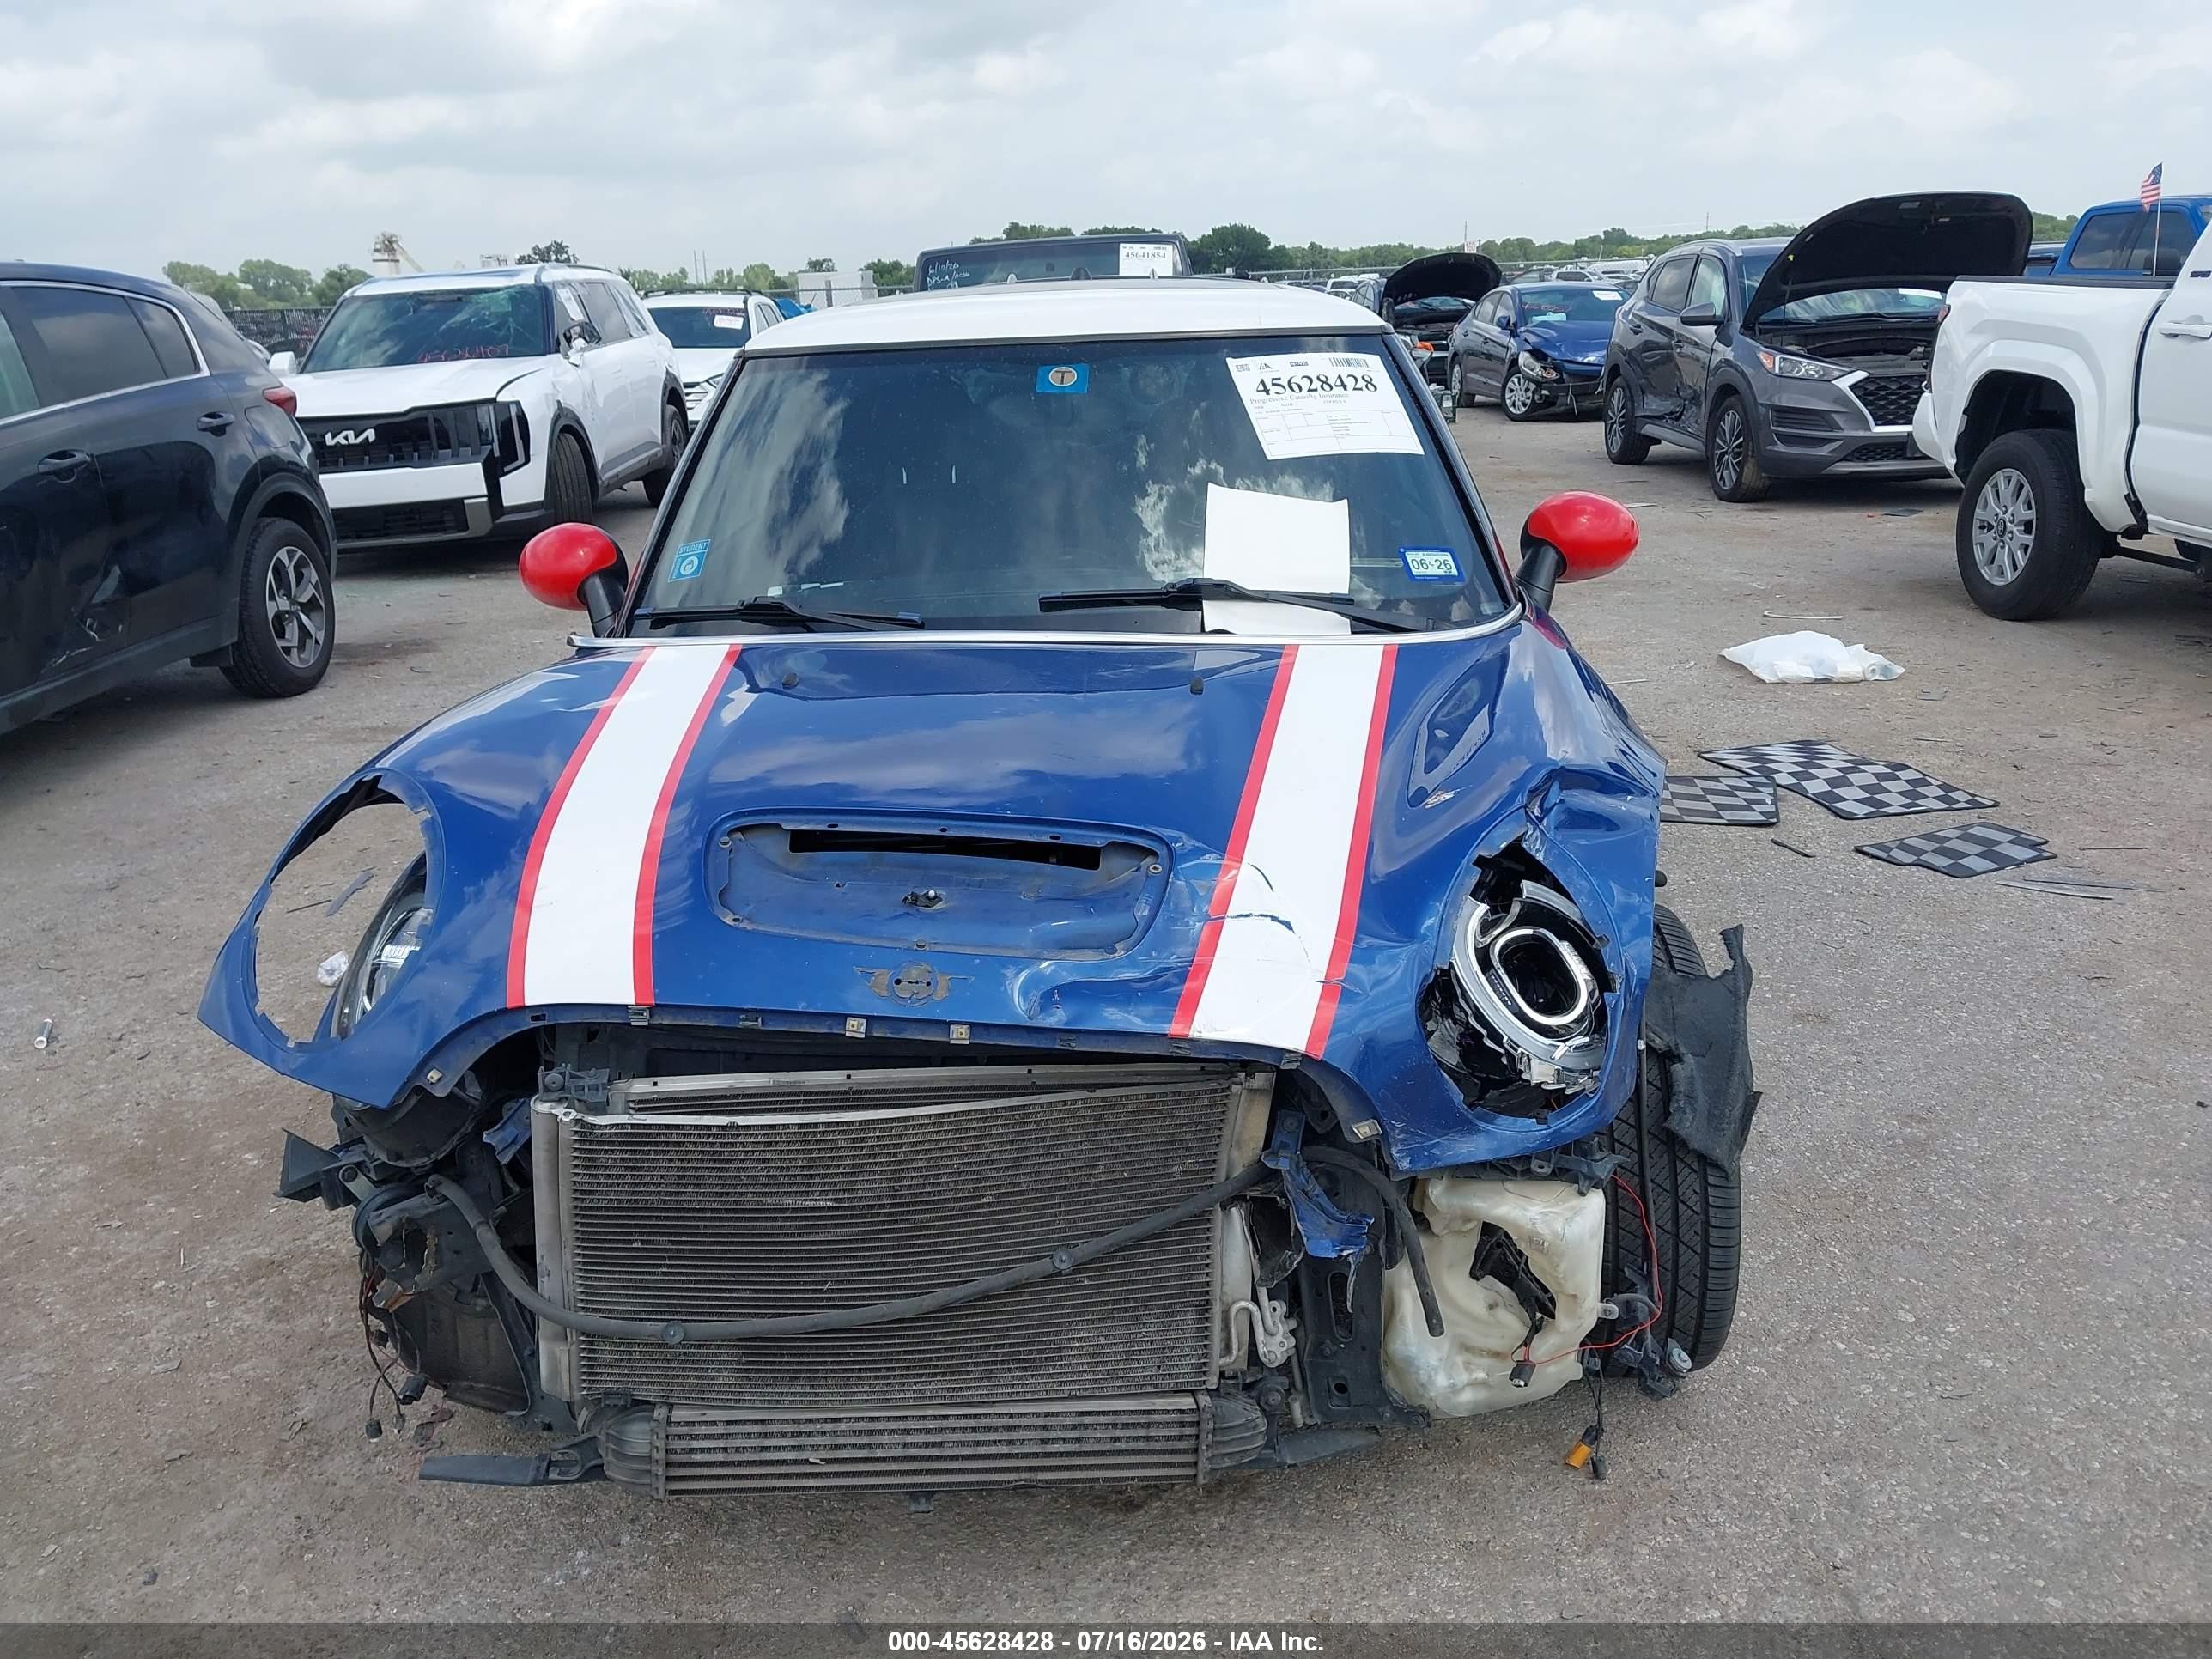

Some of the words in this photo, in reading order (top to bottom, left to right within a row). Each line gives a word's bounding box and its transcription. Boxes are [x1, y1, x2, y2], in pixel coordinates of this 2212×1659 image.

[1255, 373, 1378, 396] 45628428
[1249, 395, 1288, 404] Progressive
[678, 542, 708, 554] STUDENT
